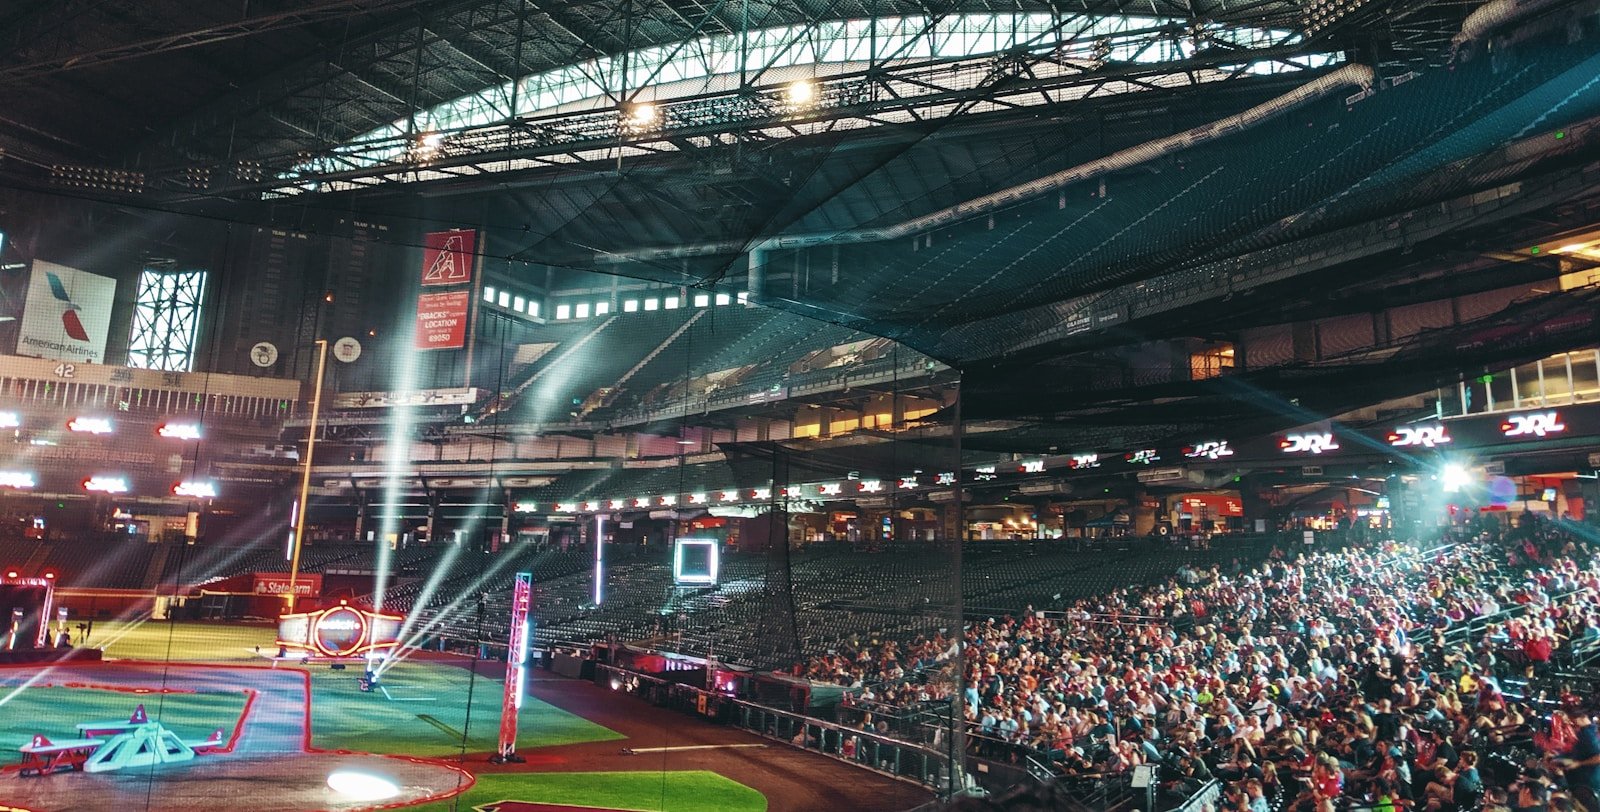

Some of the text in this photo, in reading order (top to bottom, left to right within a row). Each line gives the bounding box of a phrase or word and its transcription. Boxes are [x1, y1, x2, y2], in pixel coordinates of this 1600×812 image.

[424, 319, 458, 329] LOCATION
[22, 335, 99, 358] American Airlines
[54, 363, 76, 379] 42
[1502, 412, 1565, 437] DRL
[1281, 433, 1340, 454] DRL
[1388, 425, 1451, 448] DRL
[267, 581, 290, 594] State
[136, 710, 142, 720] 1
[35, 736, 41, 747] 2
[216, 731, 223, 741] 3
